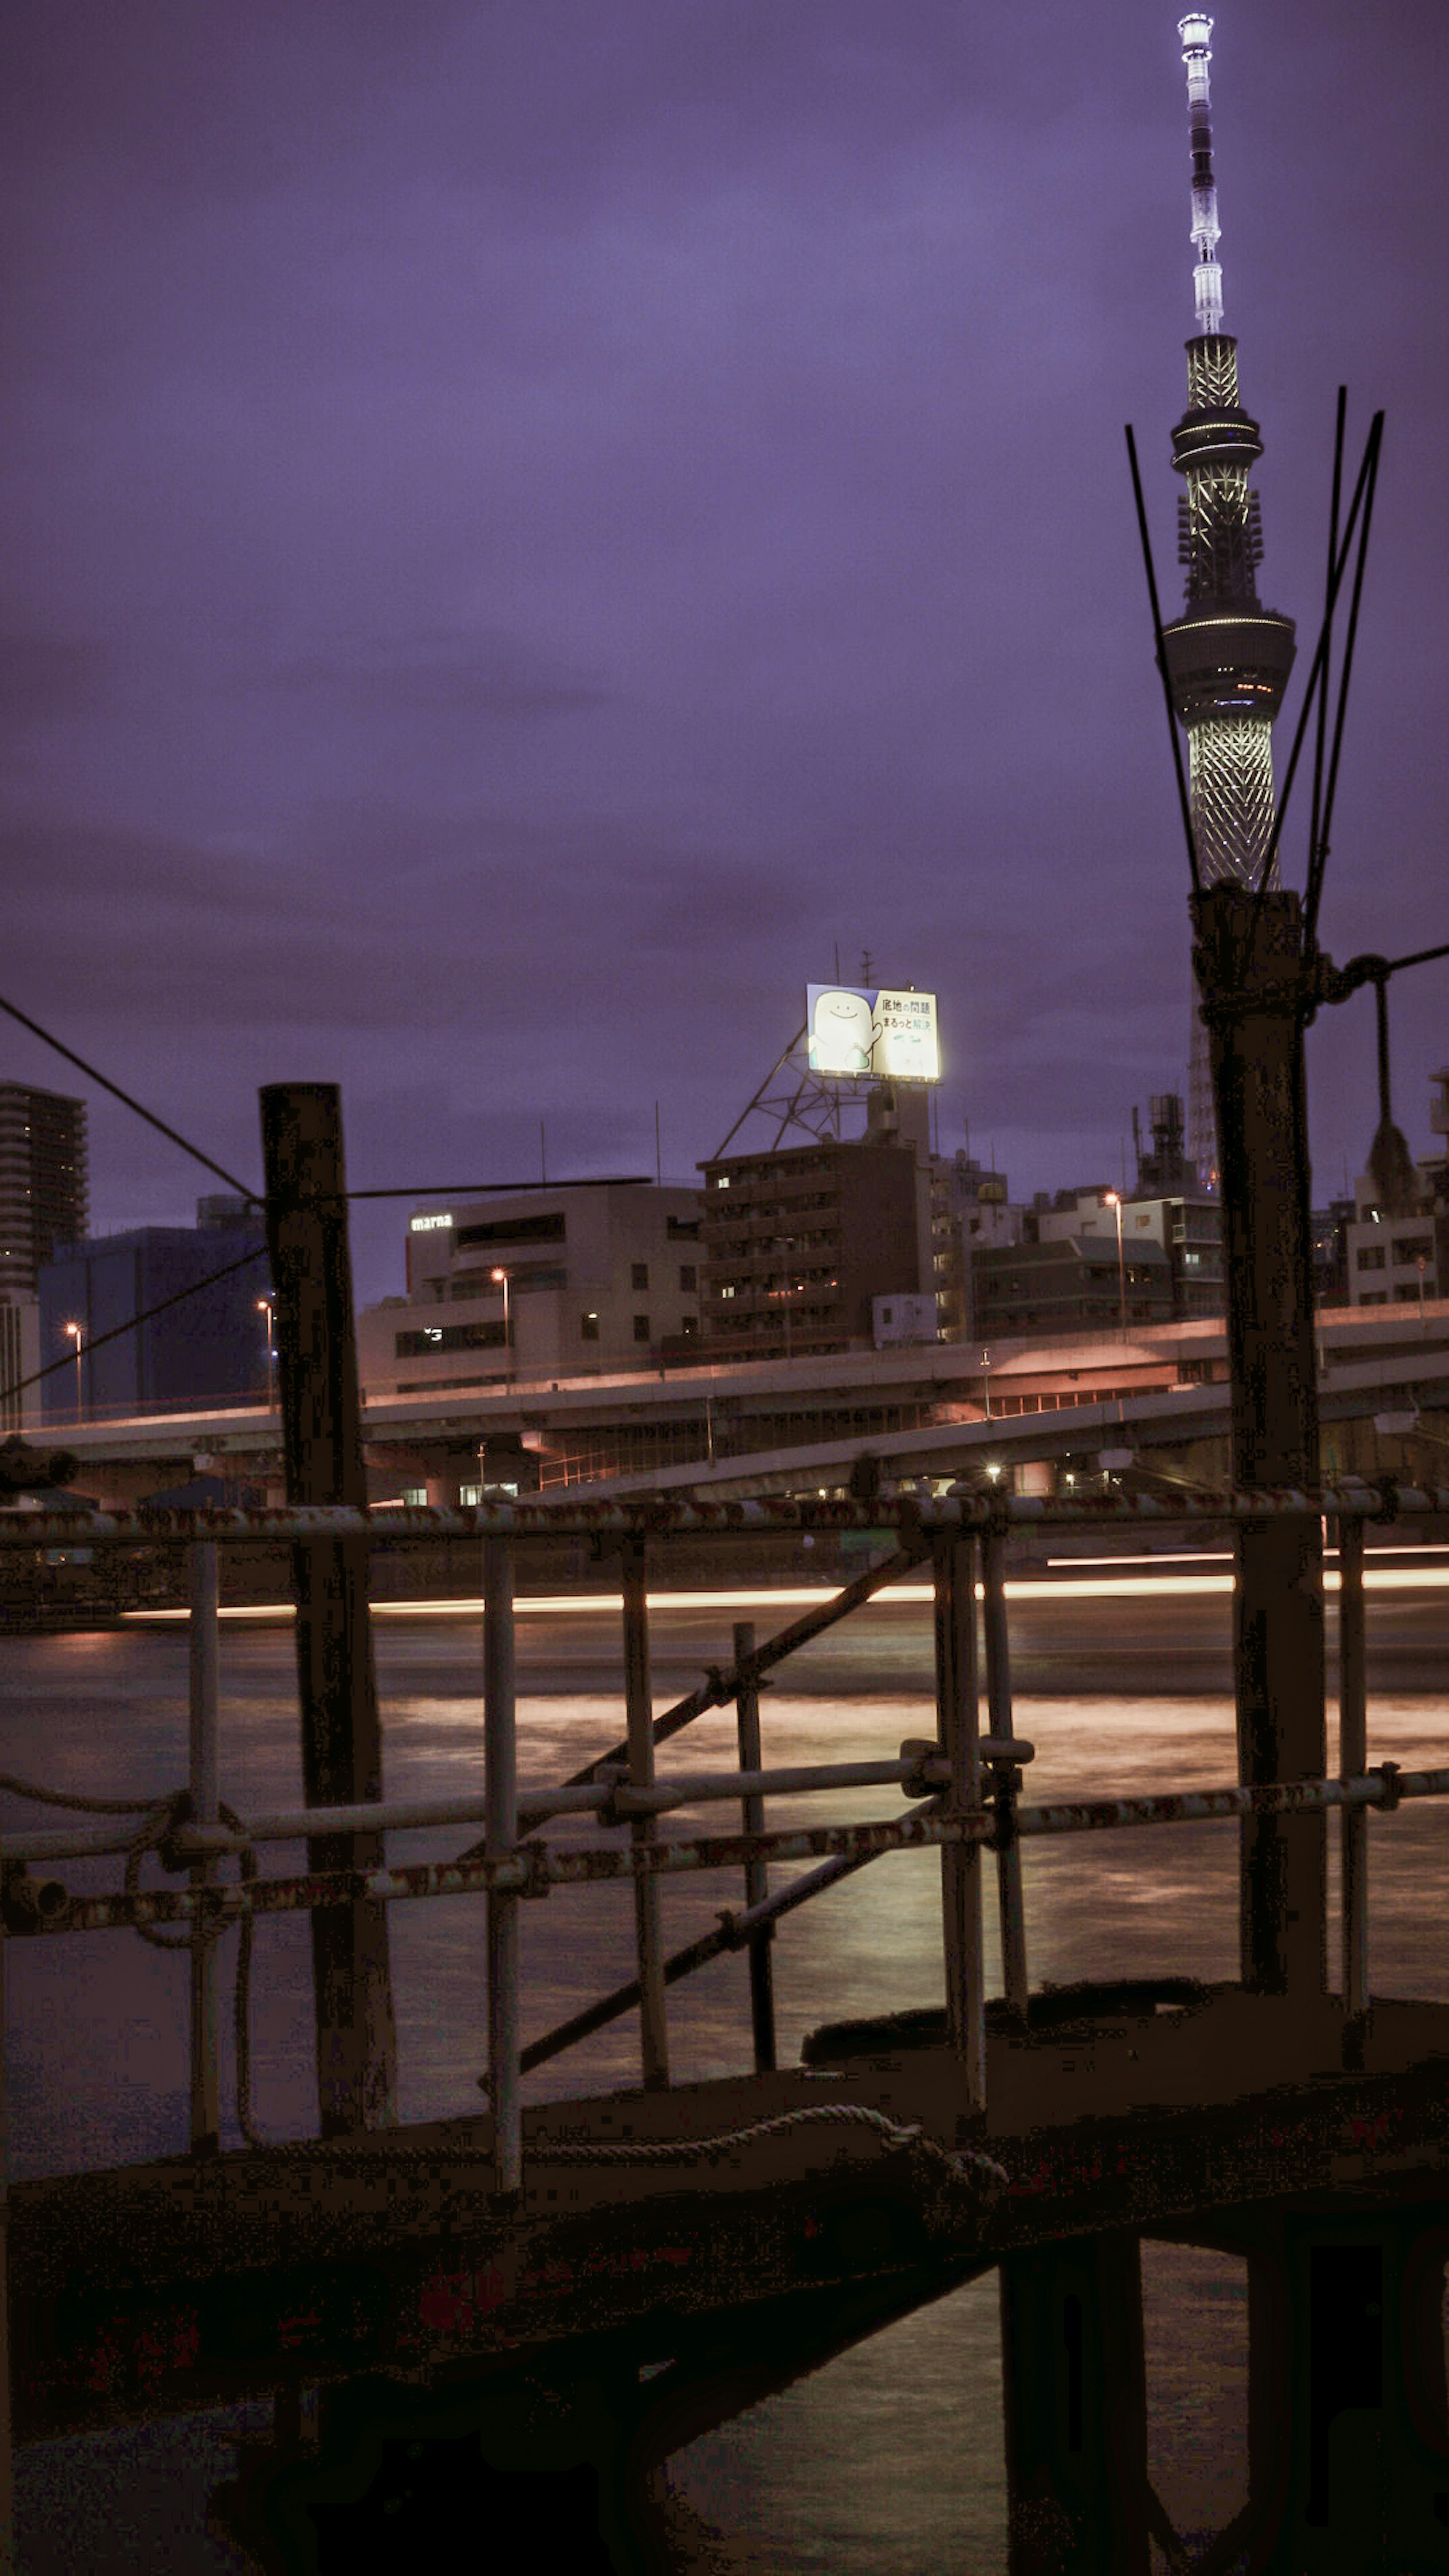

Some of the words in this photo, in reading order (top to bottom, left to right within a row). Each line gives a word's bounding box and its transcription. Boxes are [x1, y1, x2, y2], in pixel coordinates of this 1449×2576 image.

[883, 999, 930, 1014] 底地の問題
[883, 1017, 931, 1030] まるっと解決
